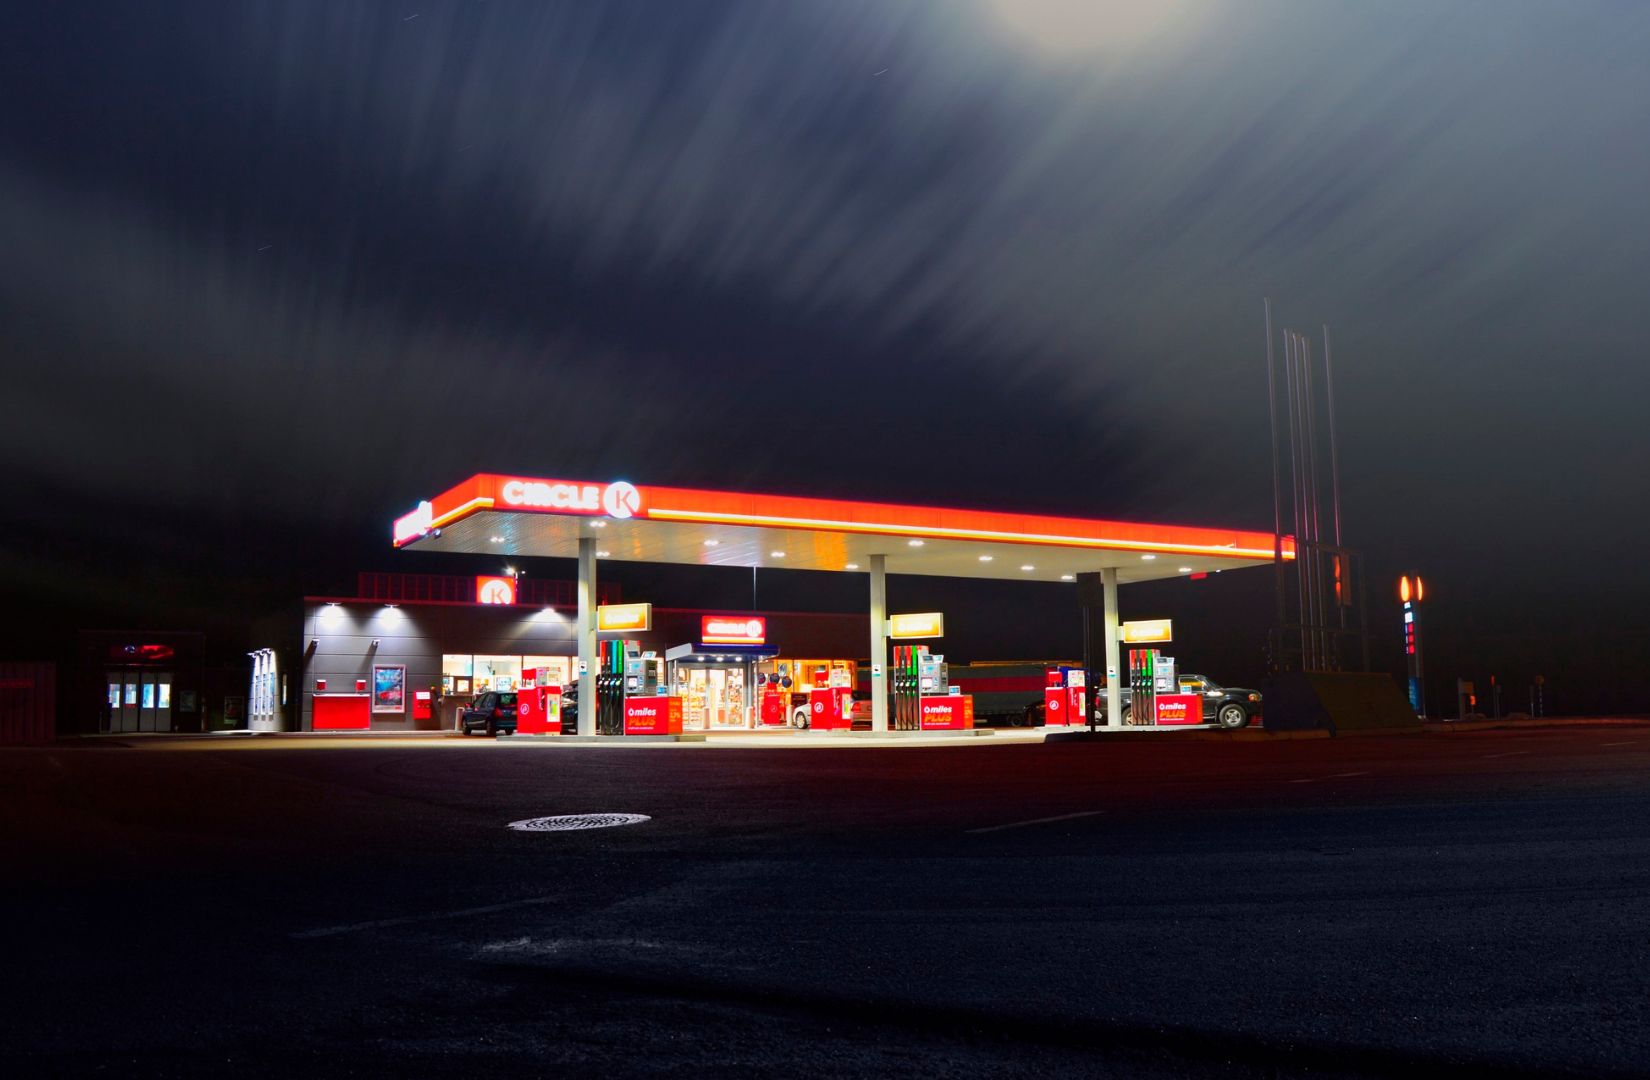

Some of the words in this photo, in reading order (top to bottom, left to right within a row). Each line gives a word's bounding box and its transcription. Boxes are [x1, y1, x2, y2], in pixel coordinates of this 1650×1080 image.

[503, 481, 600, 509] CIRCLE
[634, 708, 656, 716] miles
[1160, 710, 1185, 718] PLUS
[629, 718, 656, 726] PLUS
